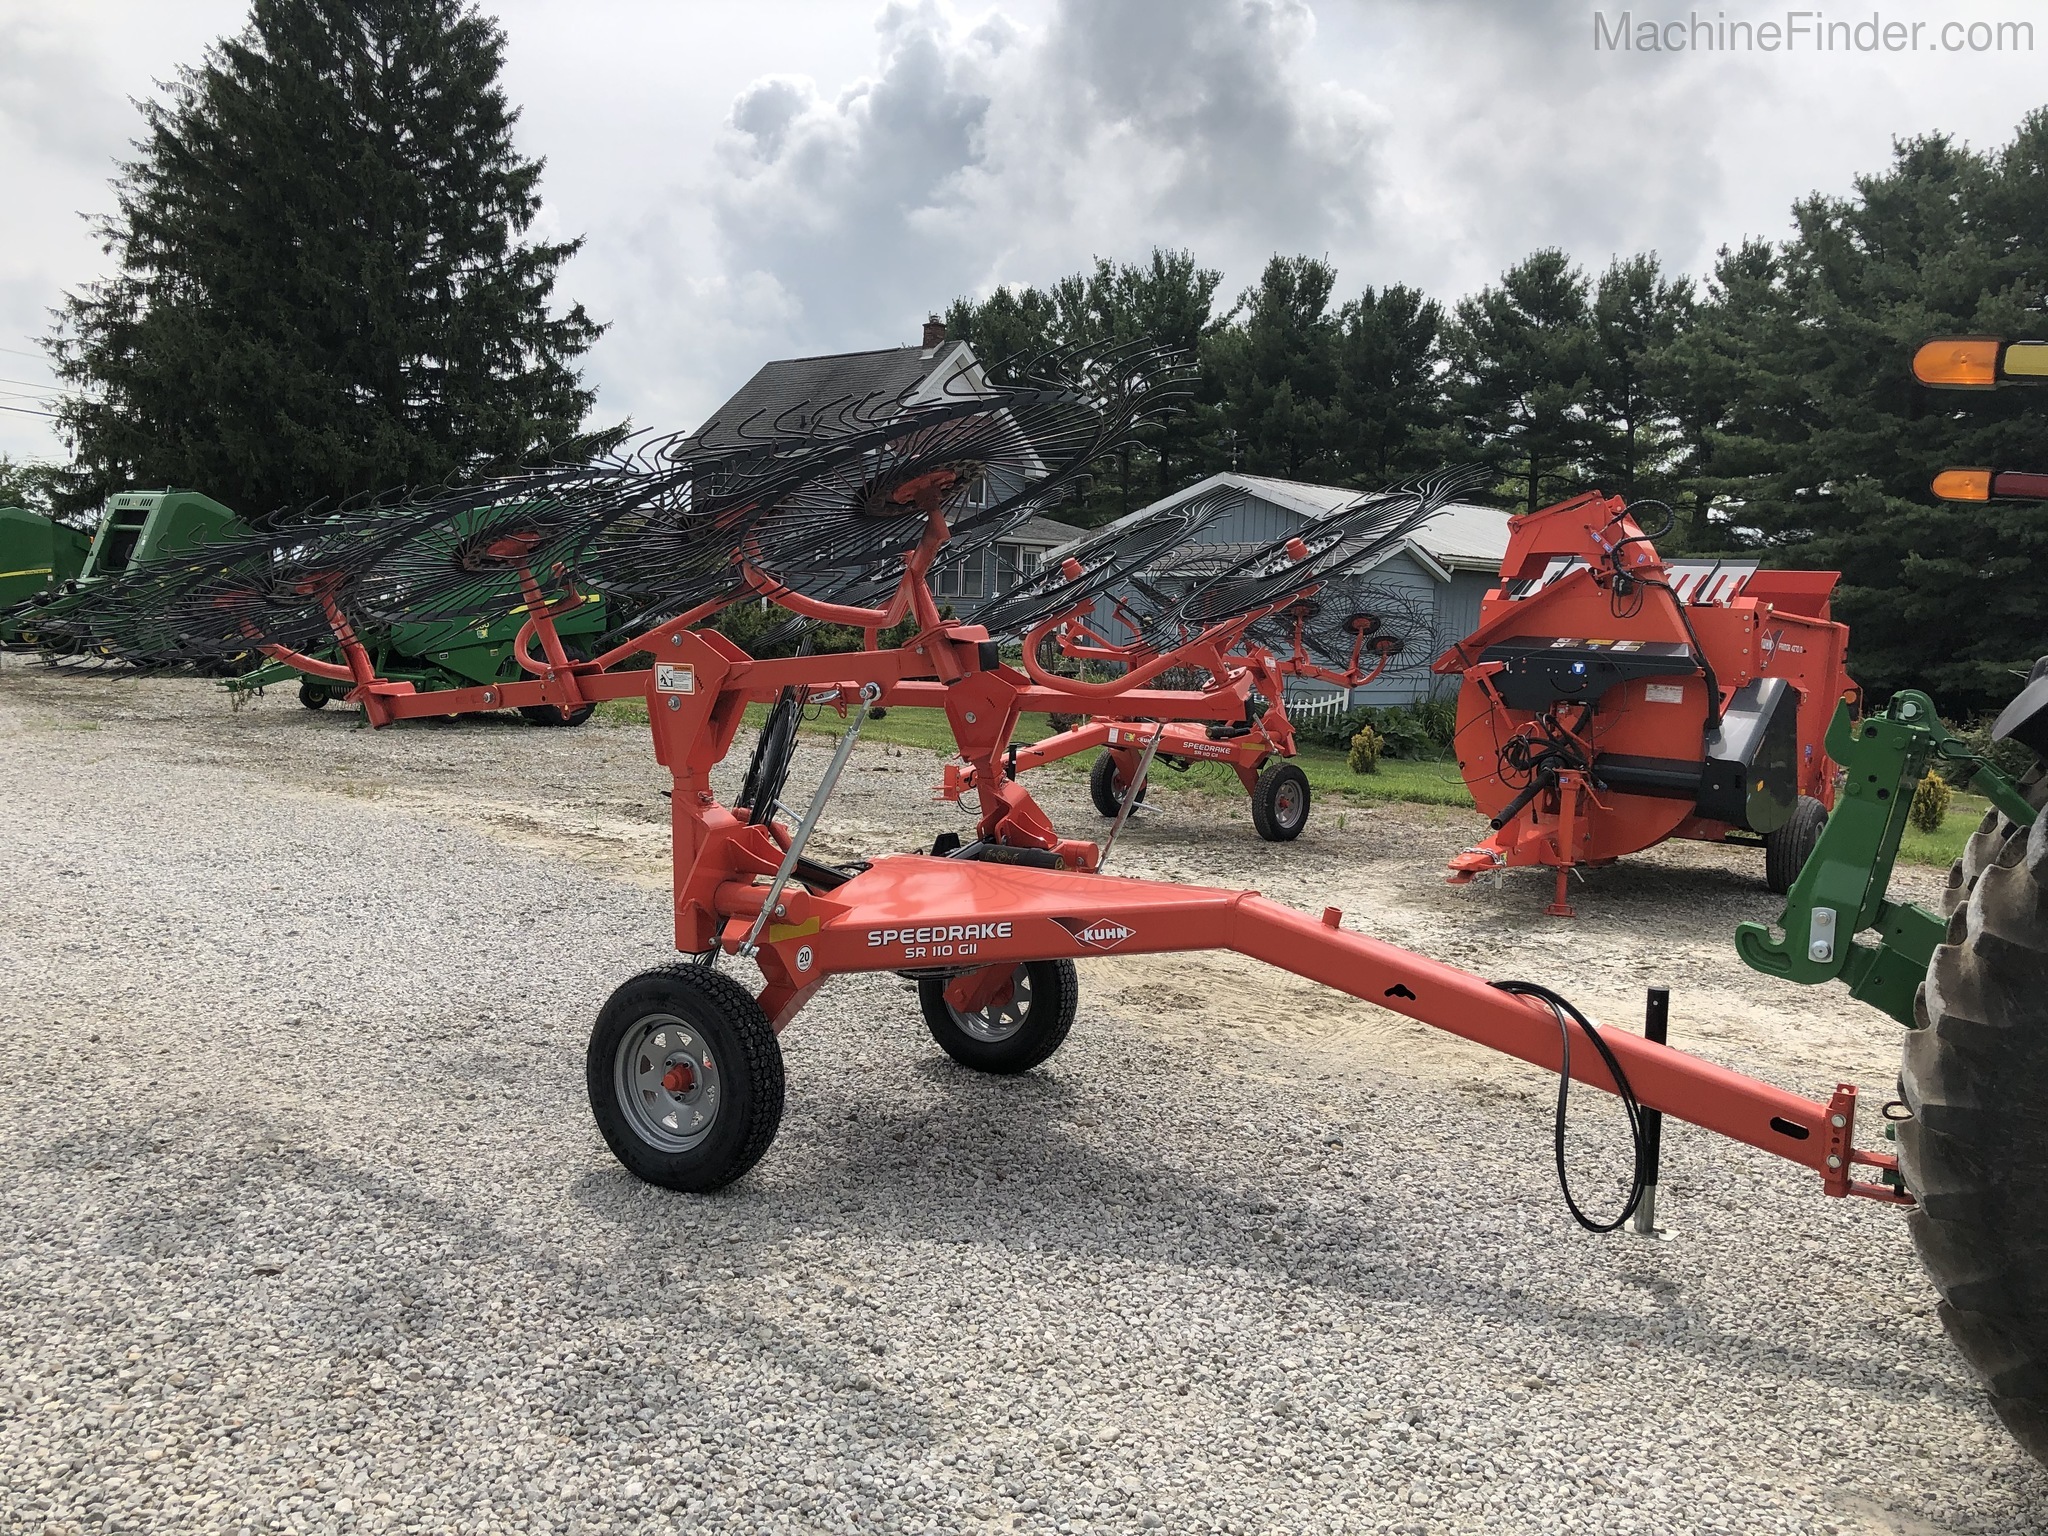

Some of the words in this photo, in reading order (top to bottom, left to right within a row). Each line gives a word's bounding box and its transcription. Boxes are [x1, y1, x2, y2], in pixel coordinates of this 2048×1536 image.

[1182, 741, 1231, 755] SPEEDRAKE
[867, 921, 1012, 947] SPEEDRAKE
[1083, 927, 1128, 941] KUHN
[799, 950, 810, 963] 20
[905, 947, 927, 959] SR
[932, 945, 953, 957] 110
